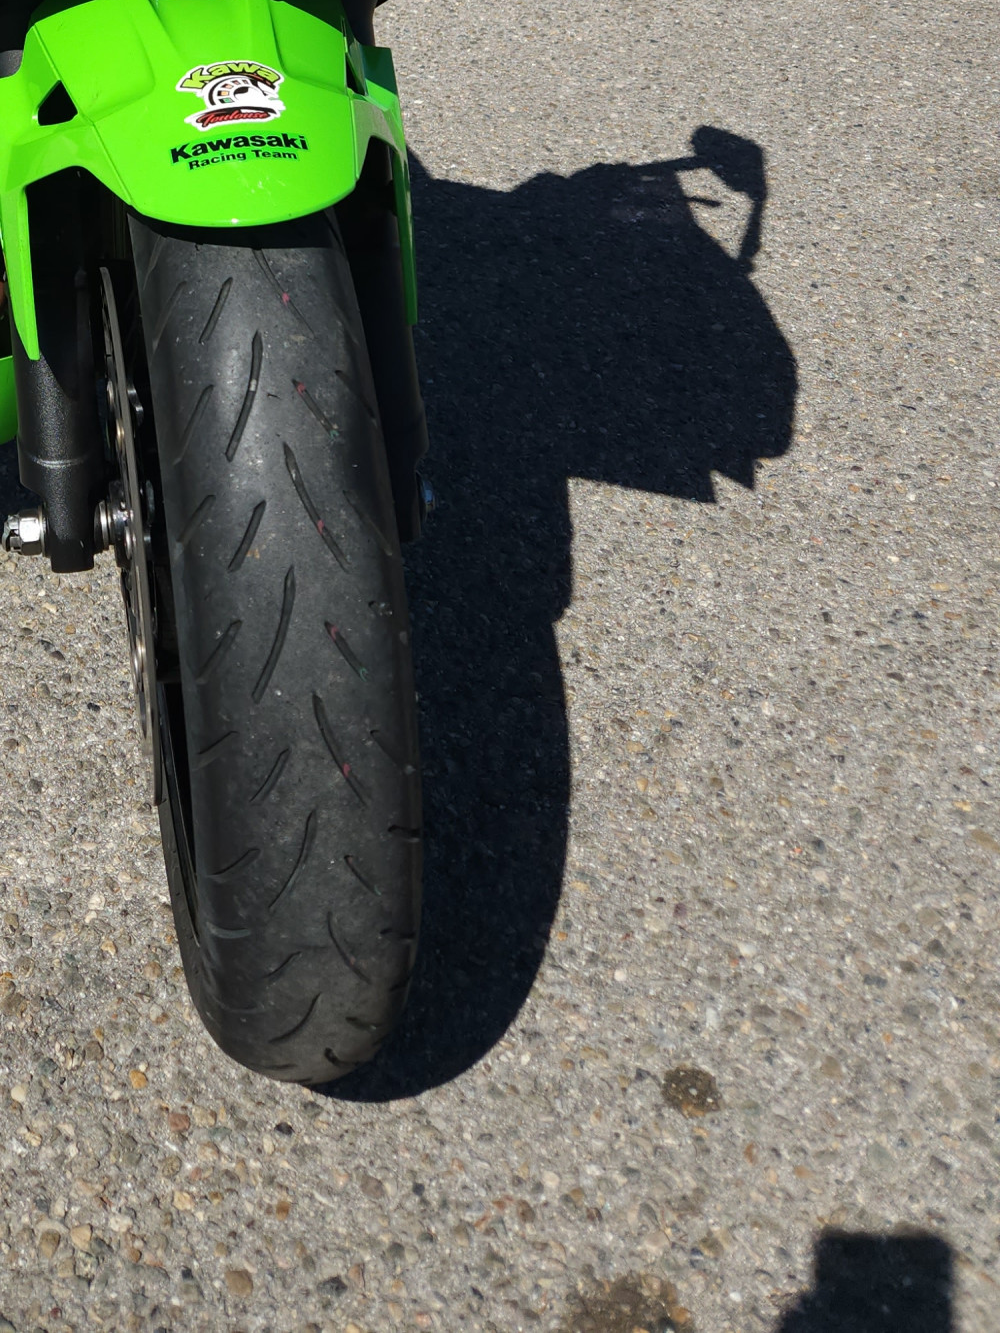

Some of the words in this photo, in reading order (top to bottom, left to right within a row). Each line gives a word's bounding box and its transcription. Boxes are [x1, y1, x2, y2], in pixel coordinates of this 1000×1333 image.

[180, 61, 281, 89] Kawa
[196, 109, 271, 127] Toulouse
[170, 133, 309, 163] Kawasaki
[188, 152, 247, 170] Racing
[251, 149, 298, 160] Team
